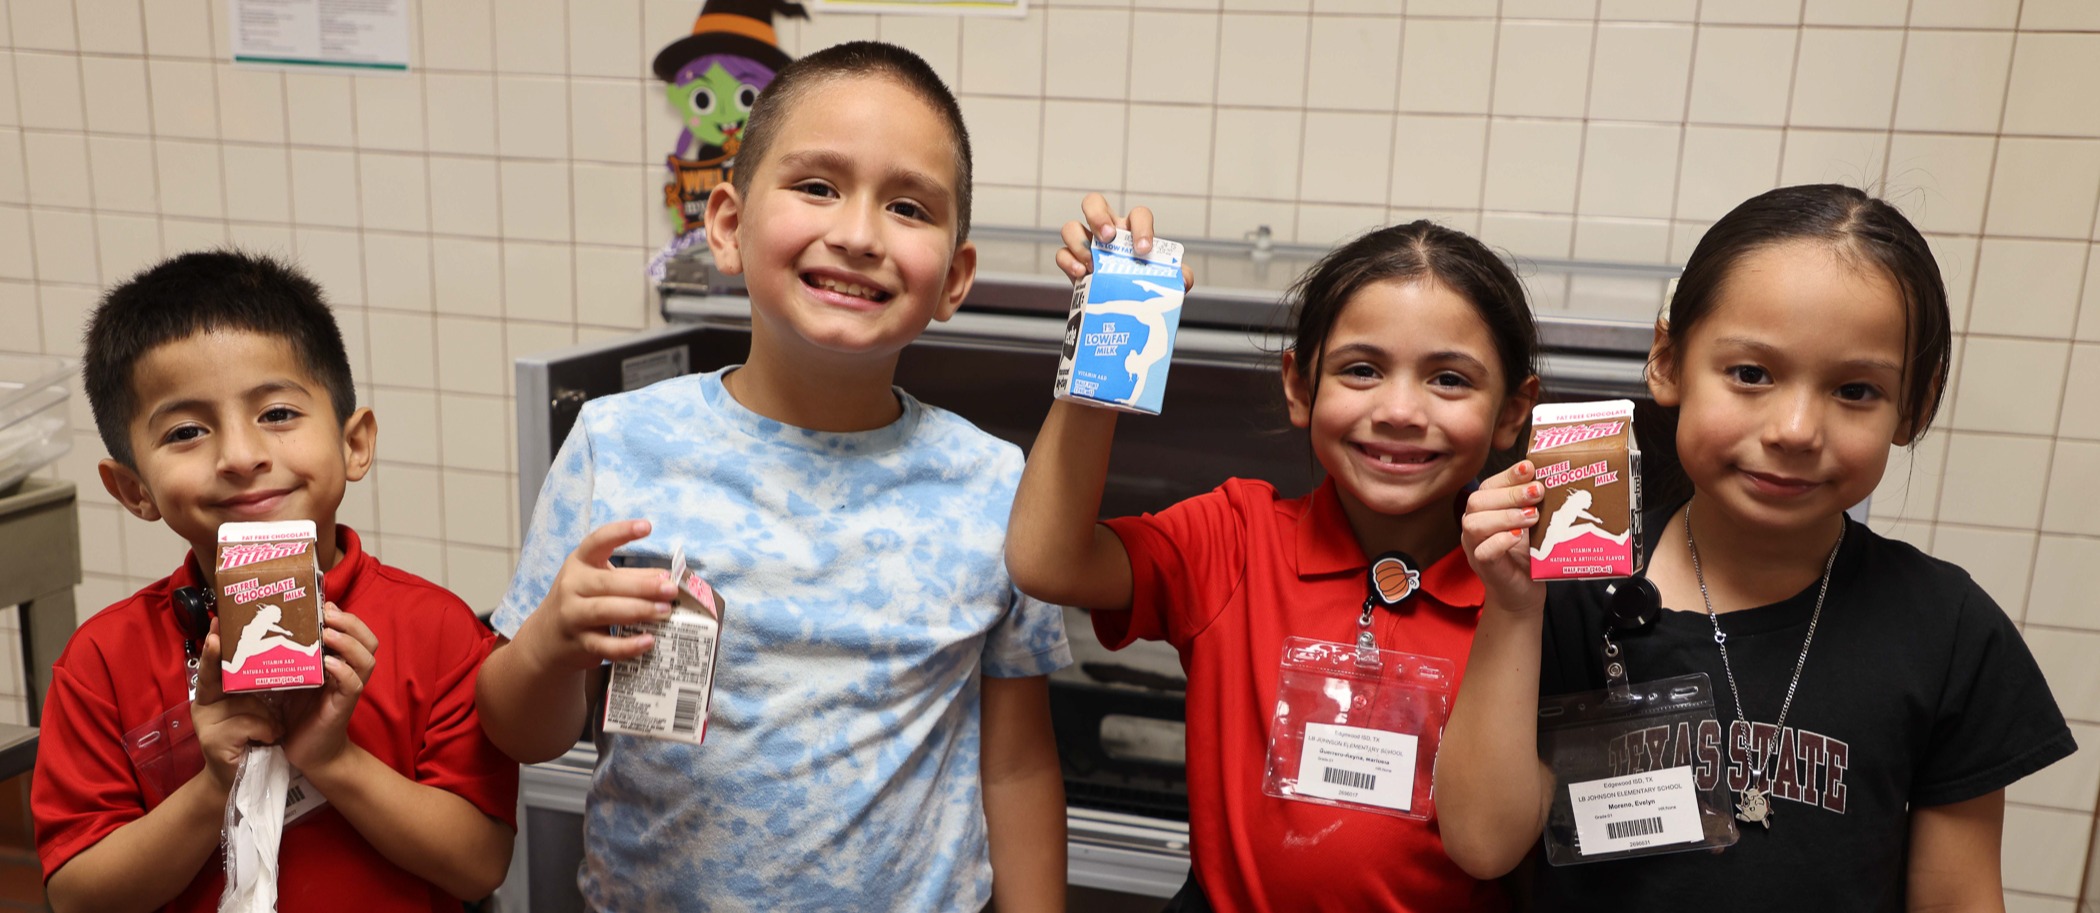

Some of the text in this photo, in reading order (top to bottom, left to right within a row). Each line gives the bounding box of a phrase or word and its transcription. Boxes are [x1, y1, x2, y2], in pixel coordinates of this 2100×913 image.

[1105, 243, 1121, 251] LOW
[1103, 322, 1116, 332] 1%
[1086, 333, 1128, 346] LOW FAT
[1096, 346, 1116, 355] MILK
[1078, 370, 1096, 378] VITAMIN
[1586, 410, 1626, 418] CHOCOLATE
[1536, 462, 1569, 478] FAT FREE
[1546, 462, 1606, 487] CHOCOLATE
[1596, 472, 1616, 486] MILK
[271, 532, 310, 540] CHOCOLATE
[225, 580, 258, 596] FAT FREE
[234, 580, 294, 604] CHOCOLATE
[284, 590, 304, 601] MILK
[1608, 720, 1848, 814] TEXAS STATE
[1603, 779, 1632, 789] Edgewood
[1588, 792, 1616, 802] JOHNSON
[1616, 786, 1656, 798] ELEMENTARY
[1657, 783, 1682, 792] SCHOOL
[1608, 799, 1656, 810] Moreno, Evelyn
